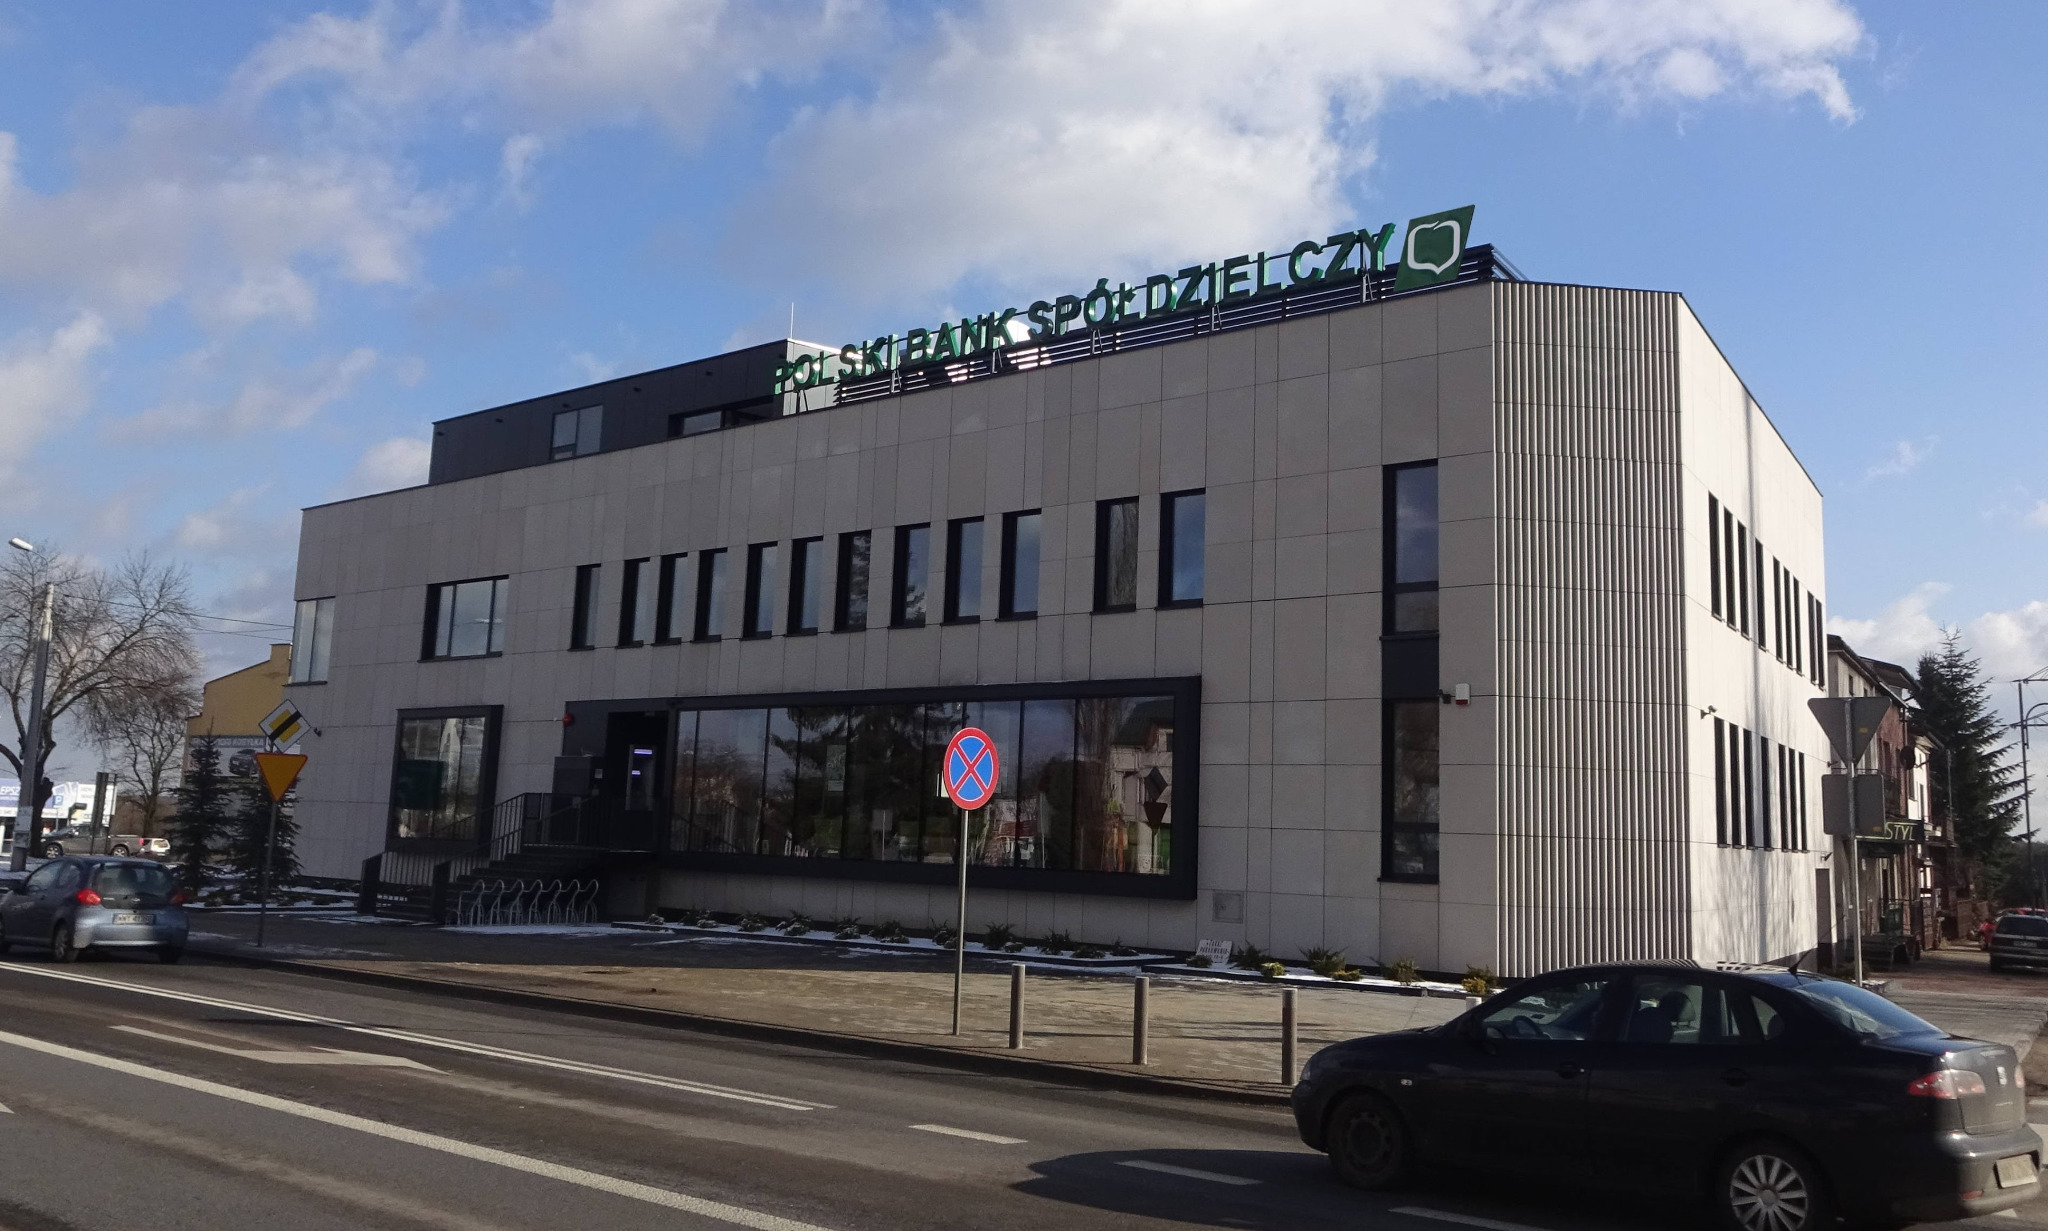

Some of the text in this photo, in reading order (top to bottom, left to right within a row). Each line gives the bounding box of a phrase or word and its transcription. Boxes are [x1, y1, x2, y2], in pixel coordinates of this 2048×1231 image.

[773, 222, 1396, 395] POLSKI BANK SPÓŁDZIELCZY
[1884, 821, 1918, 841] STYL
